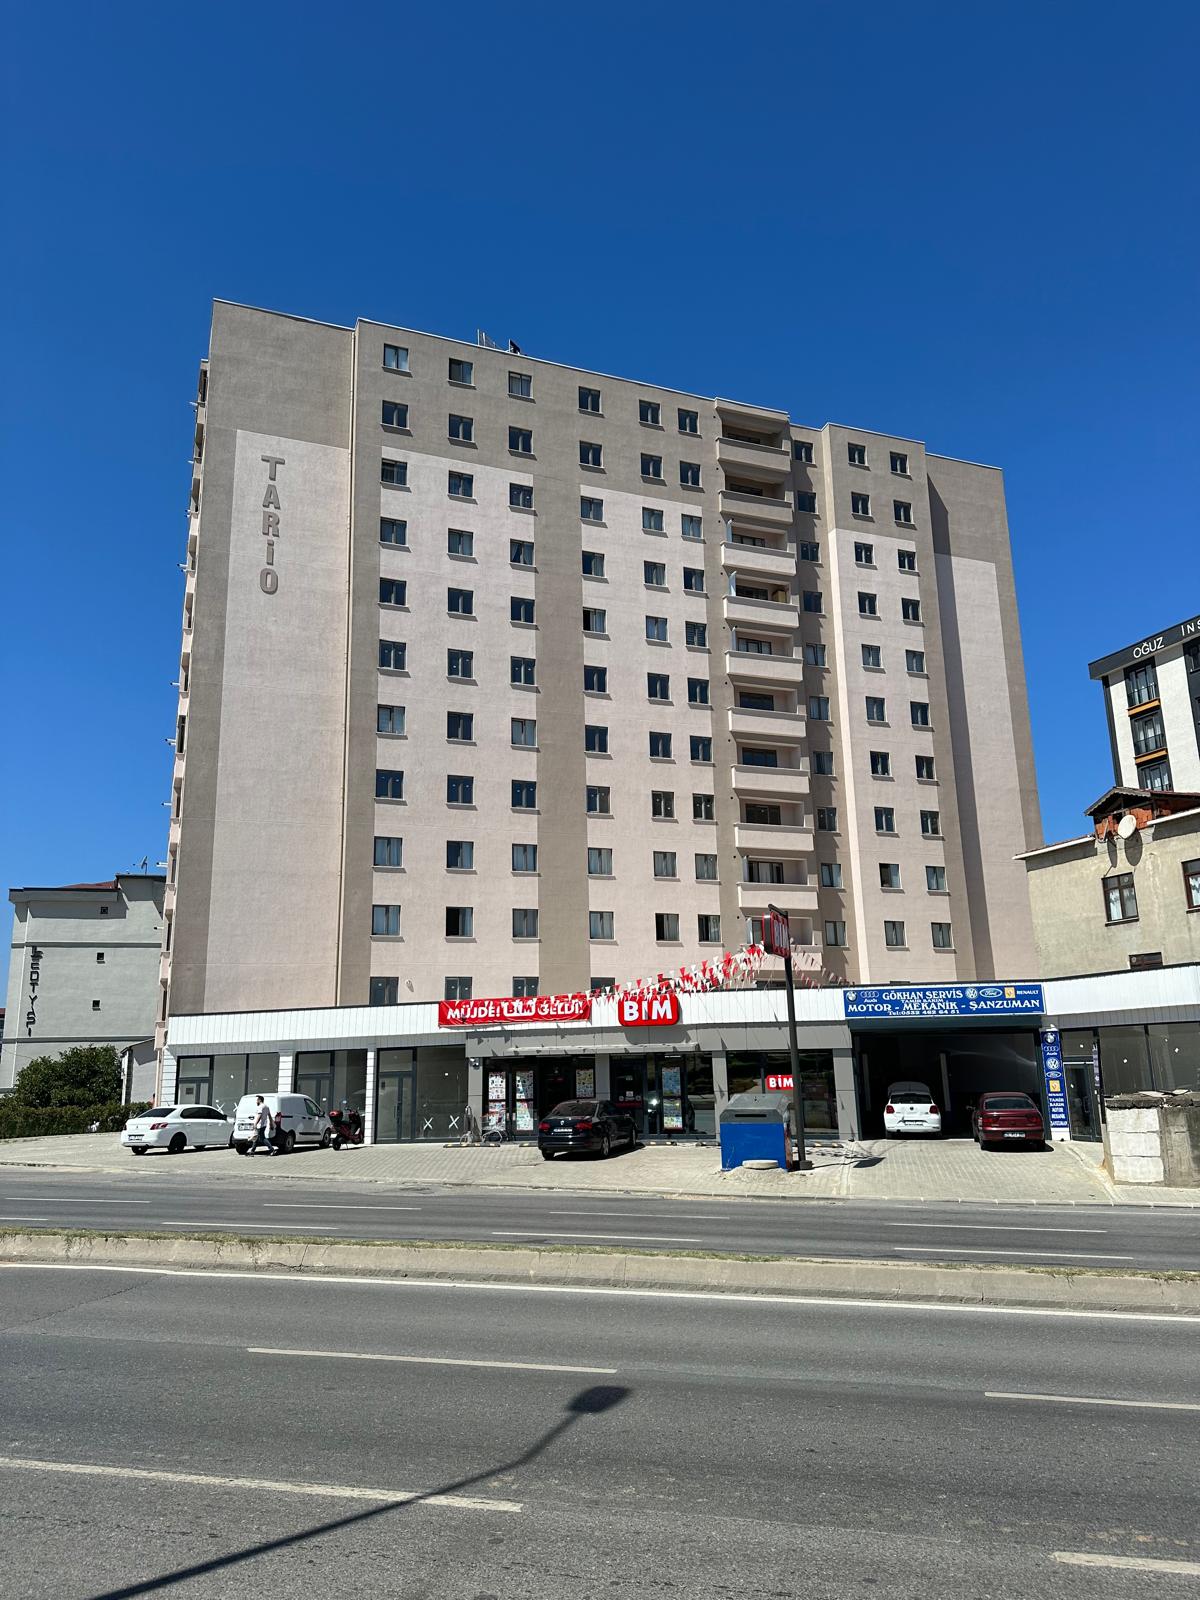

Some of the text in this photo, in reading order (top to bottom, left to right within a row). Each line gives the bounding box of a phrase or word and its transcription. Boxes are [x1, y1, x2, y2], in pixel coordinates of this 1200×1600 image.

[1133, 637, 1164, 658] OĞUZ
[882, 988, 963, 1000] GÖKHAN SERVİS
[848, 1003, 892, 1012] MOTOR
[903, 1000, 958, 1010] MEKANİK
[969, 1000, 1040, 1011] ŞANZUMAN
[769, 1075, 794, 1087] BİM
